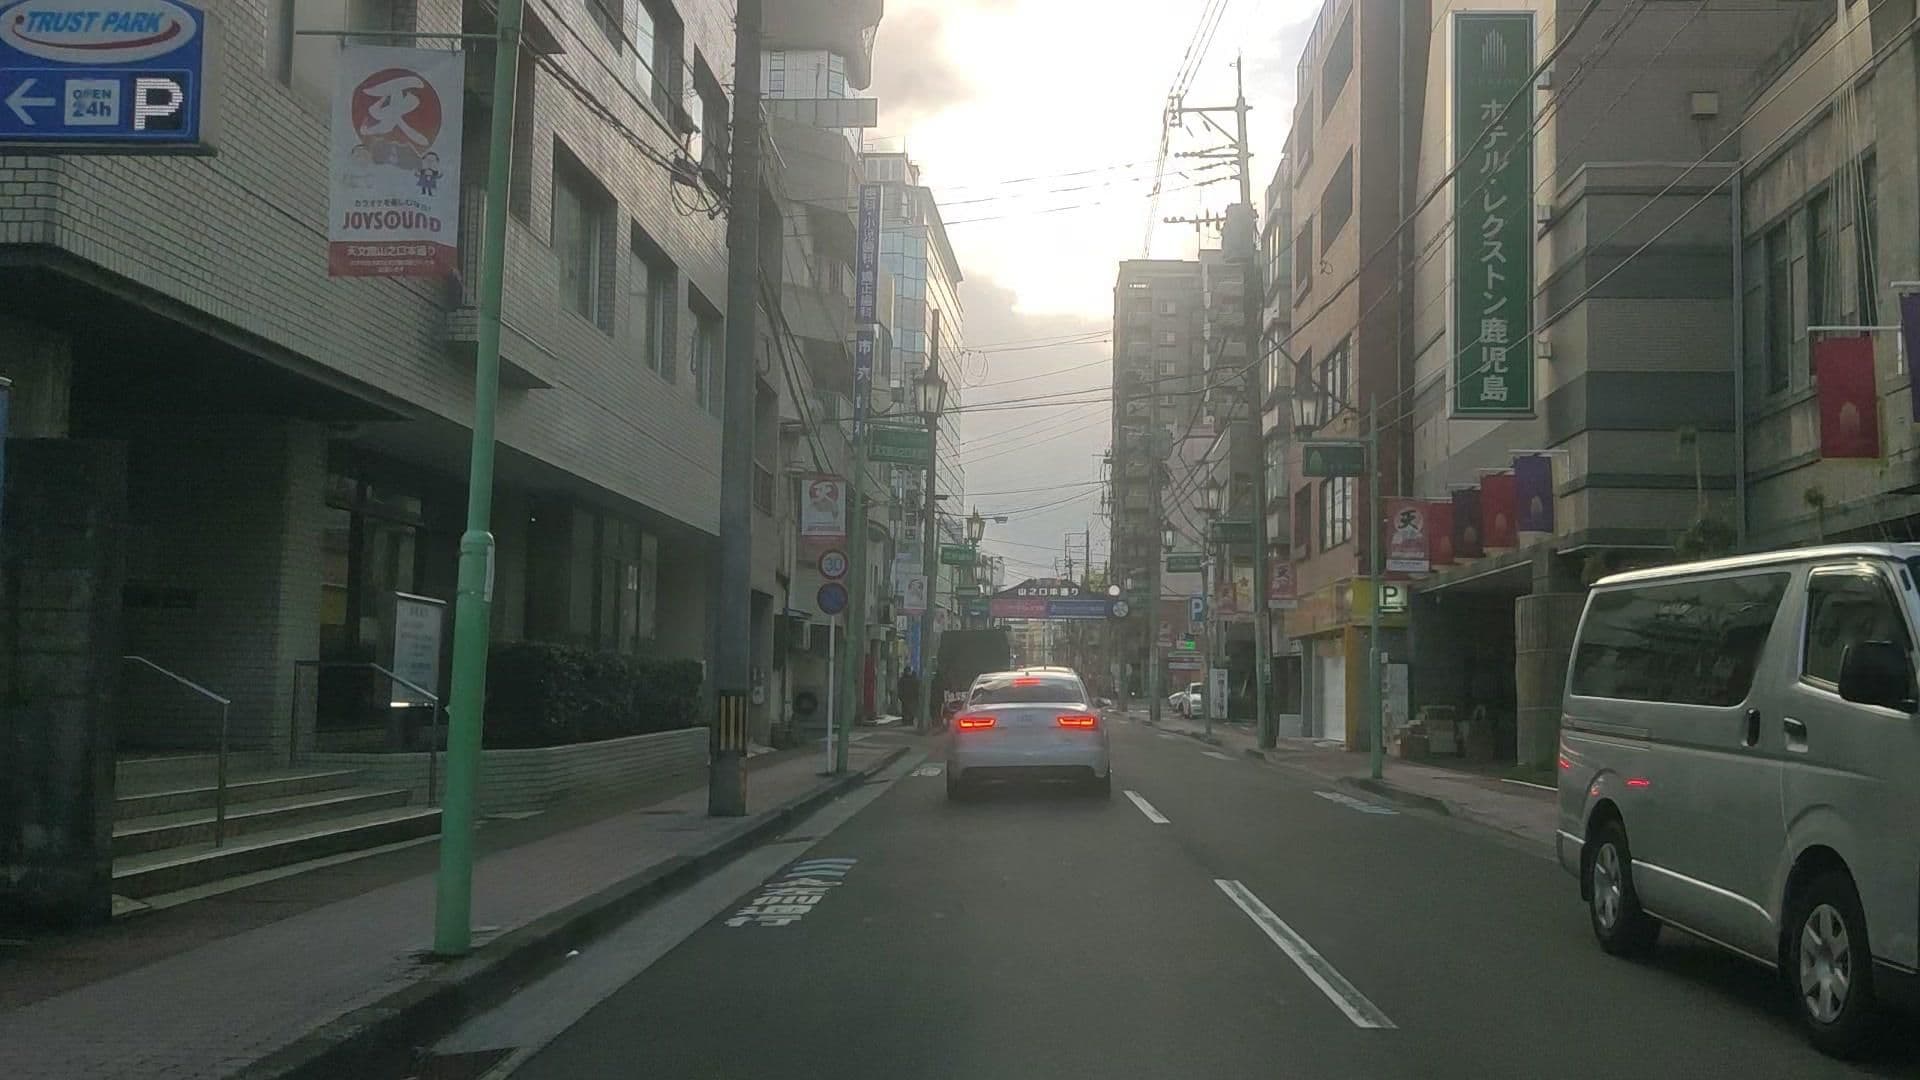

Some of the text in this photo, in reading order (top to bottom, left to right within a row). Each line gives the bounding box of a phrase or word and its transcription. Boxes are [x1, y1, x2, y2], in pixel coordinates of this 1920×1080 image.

[26, 11, 164, 33] TRUST PARK
[72, 89, 112, 100] OPEN
[134, 77, 184, 131] P
[71, 101, 112, 118] 24h
[342, 209, 442, 232] JOYSOUND
[1478, 98, 1509, 403] ホテル・レクストン鹿児島
[824, 558, 843, 572] 30
[1382, 585, 1398, 605] P
